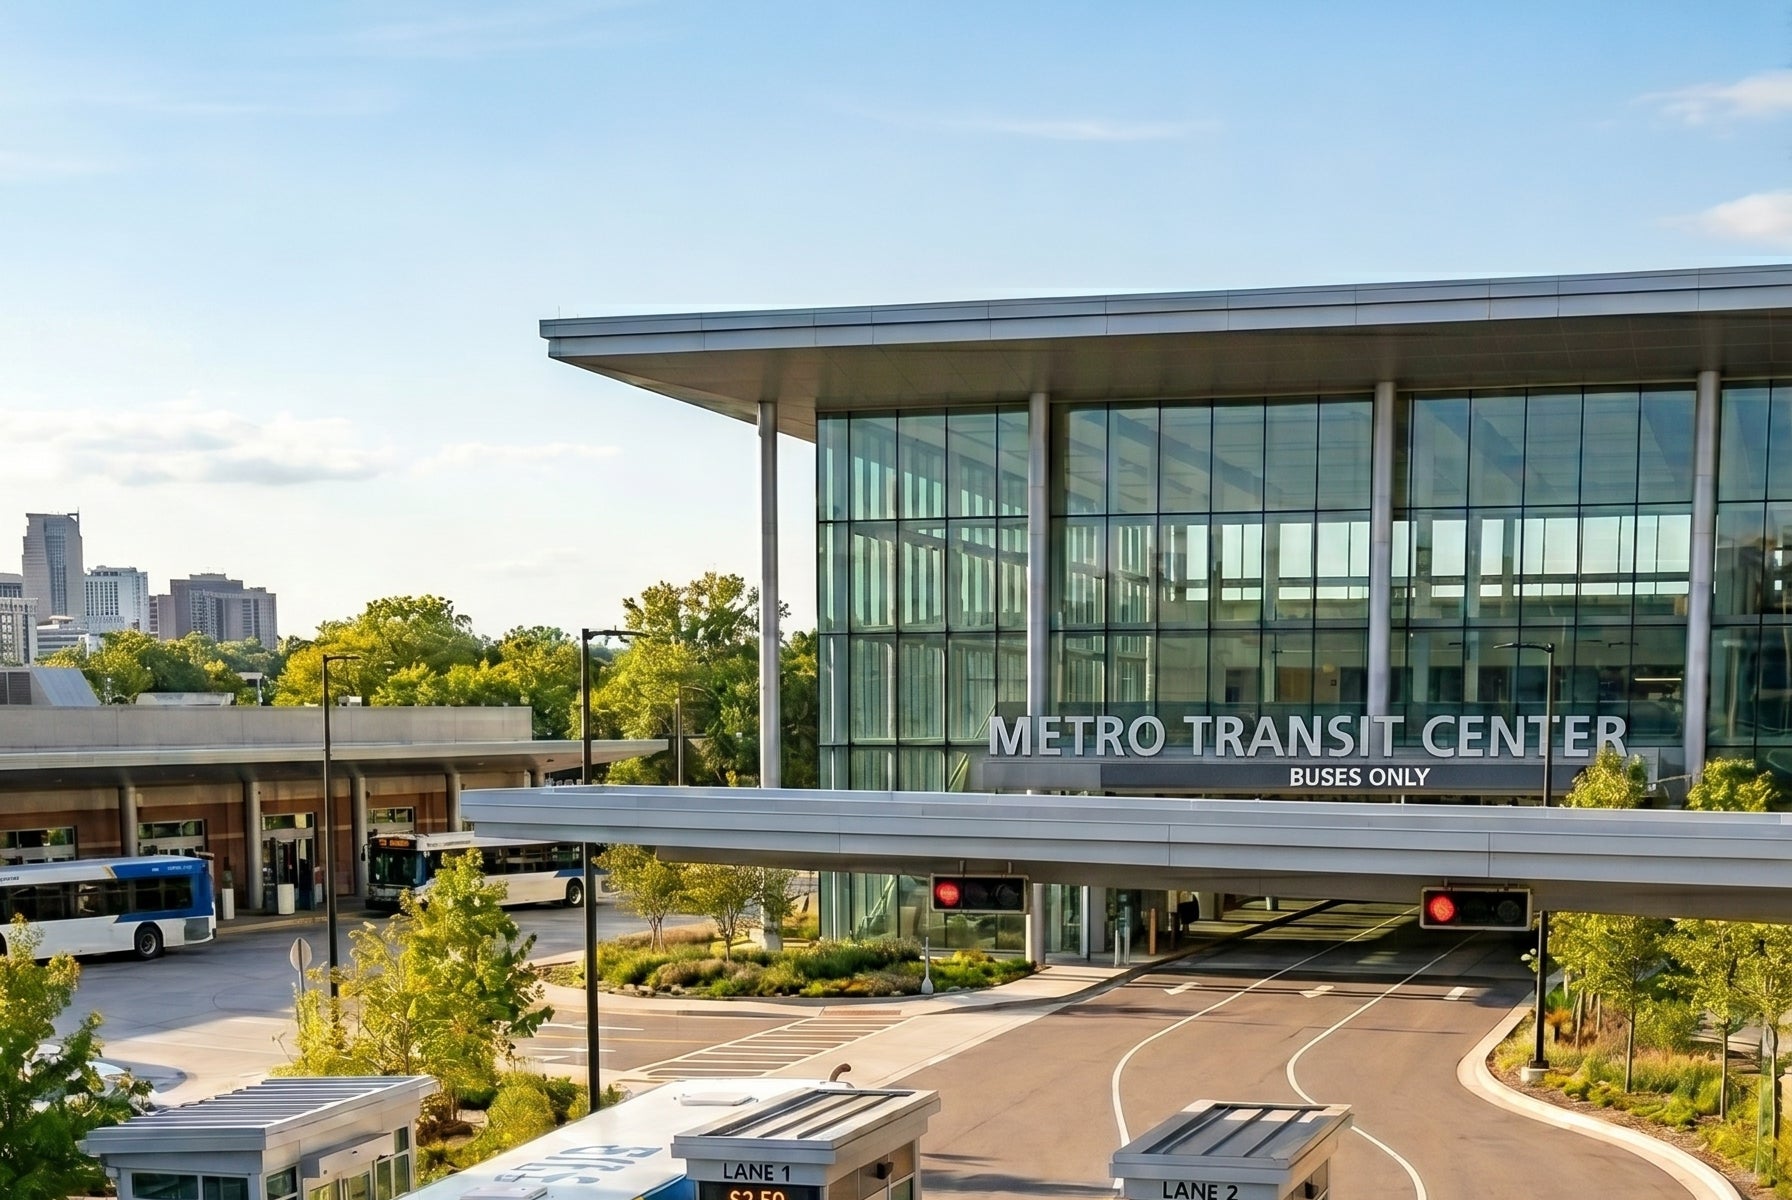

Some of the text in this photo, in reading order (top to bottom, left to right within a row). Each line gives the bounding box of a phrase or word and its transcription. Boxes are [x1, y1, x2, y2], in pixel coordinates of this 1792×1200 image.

[989, 715, 1627, 758] METRO TRANSIT CENTER
[1290, 768, 1431, 787] BUSES ONLY
[723, 1162, 790, 1182] LANE 1
